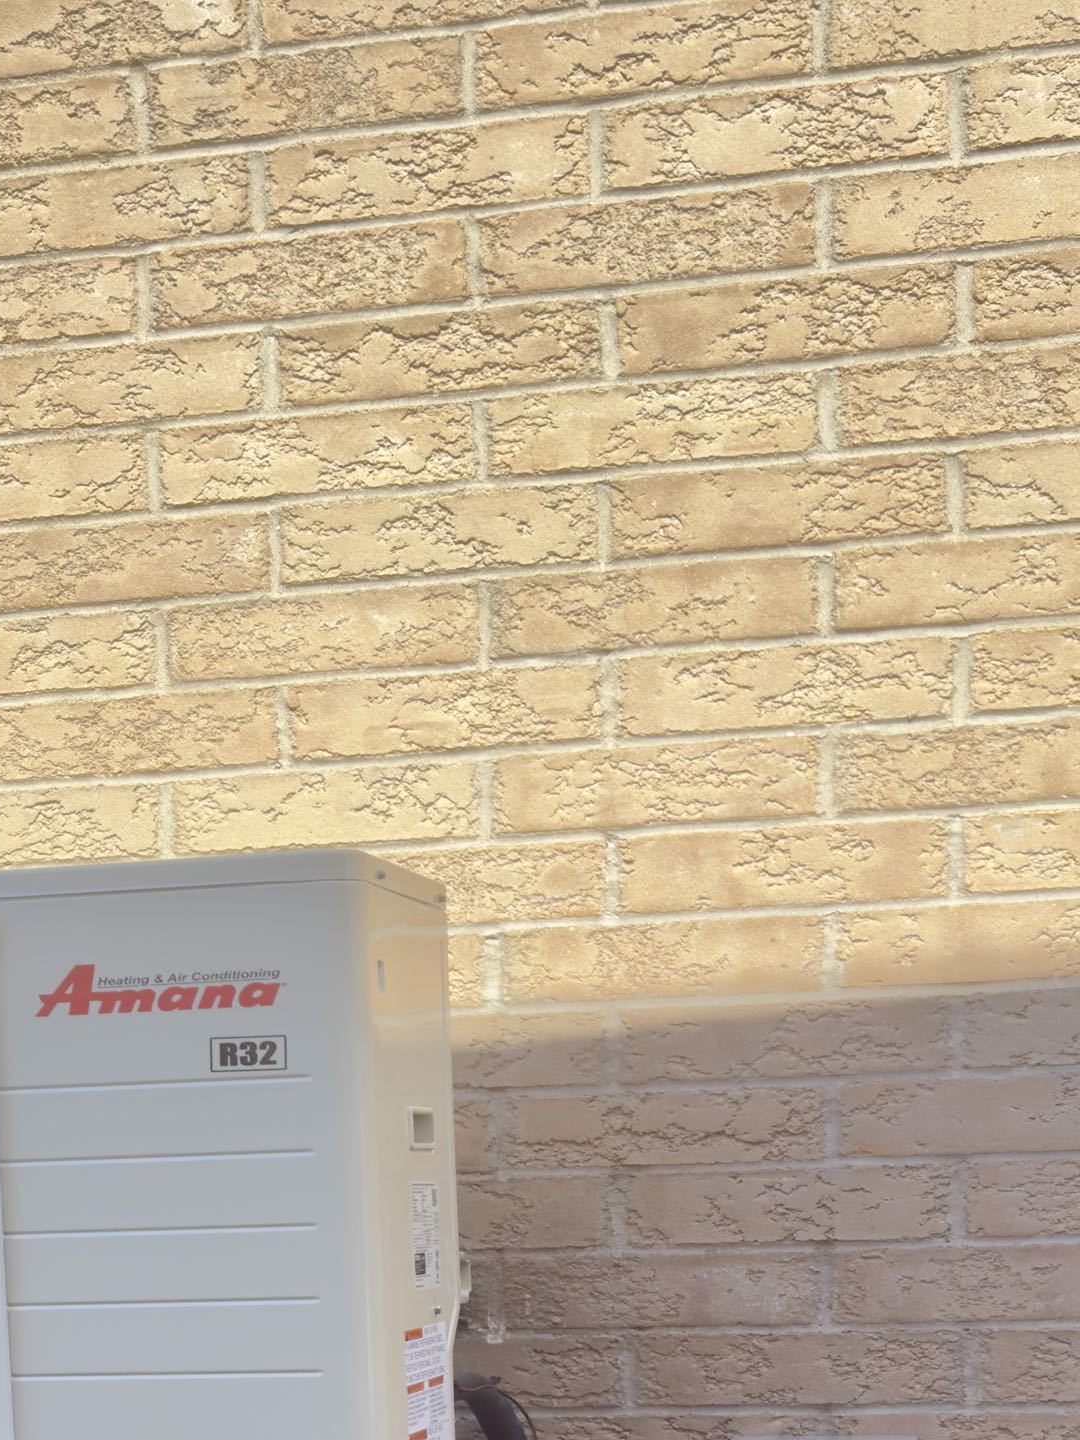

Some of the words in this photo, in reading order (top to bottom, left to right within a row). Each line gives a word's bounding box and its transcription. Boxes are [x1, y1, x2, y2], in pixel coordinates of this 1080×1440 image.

[35, 964, 281, 1018] Amana
[97, 974, 150, 987] Heating
[153, 974, 163, 984] &
[167, 972, 187, 983] Air
[191, 969, 281, 982] Conditioning
[219, 1041, 277, 1067] R32
